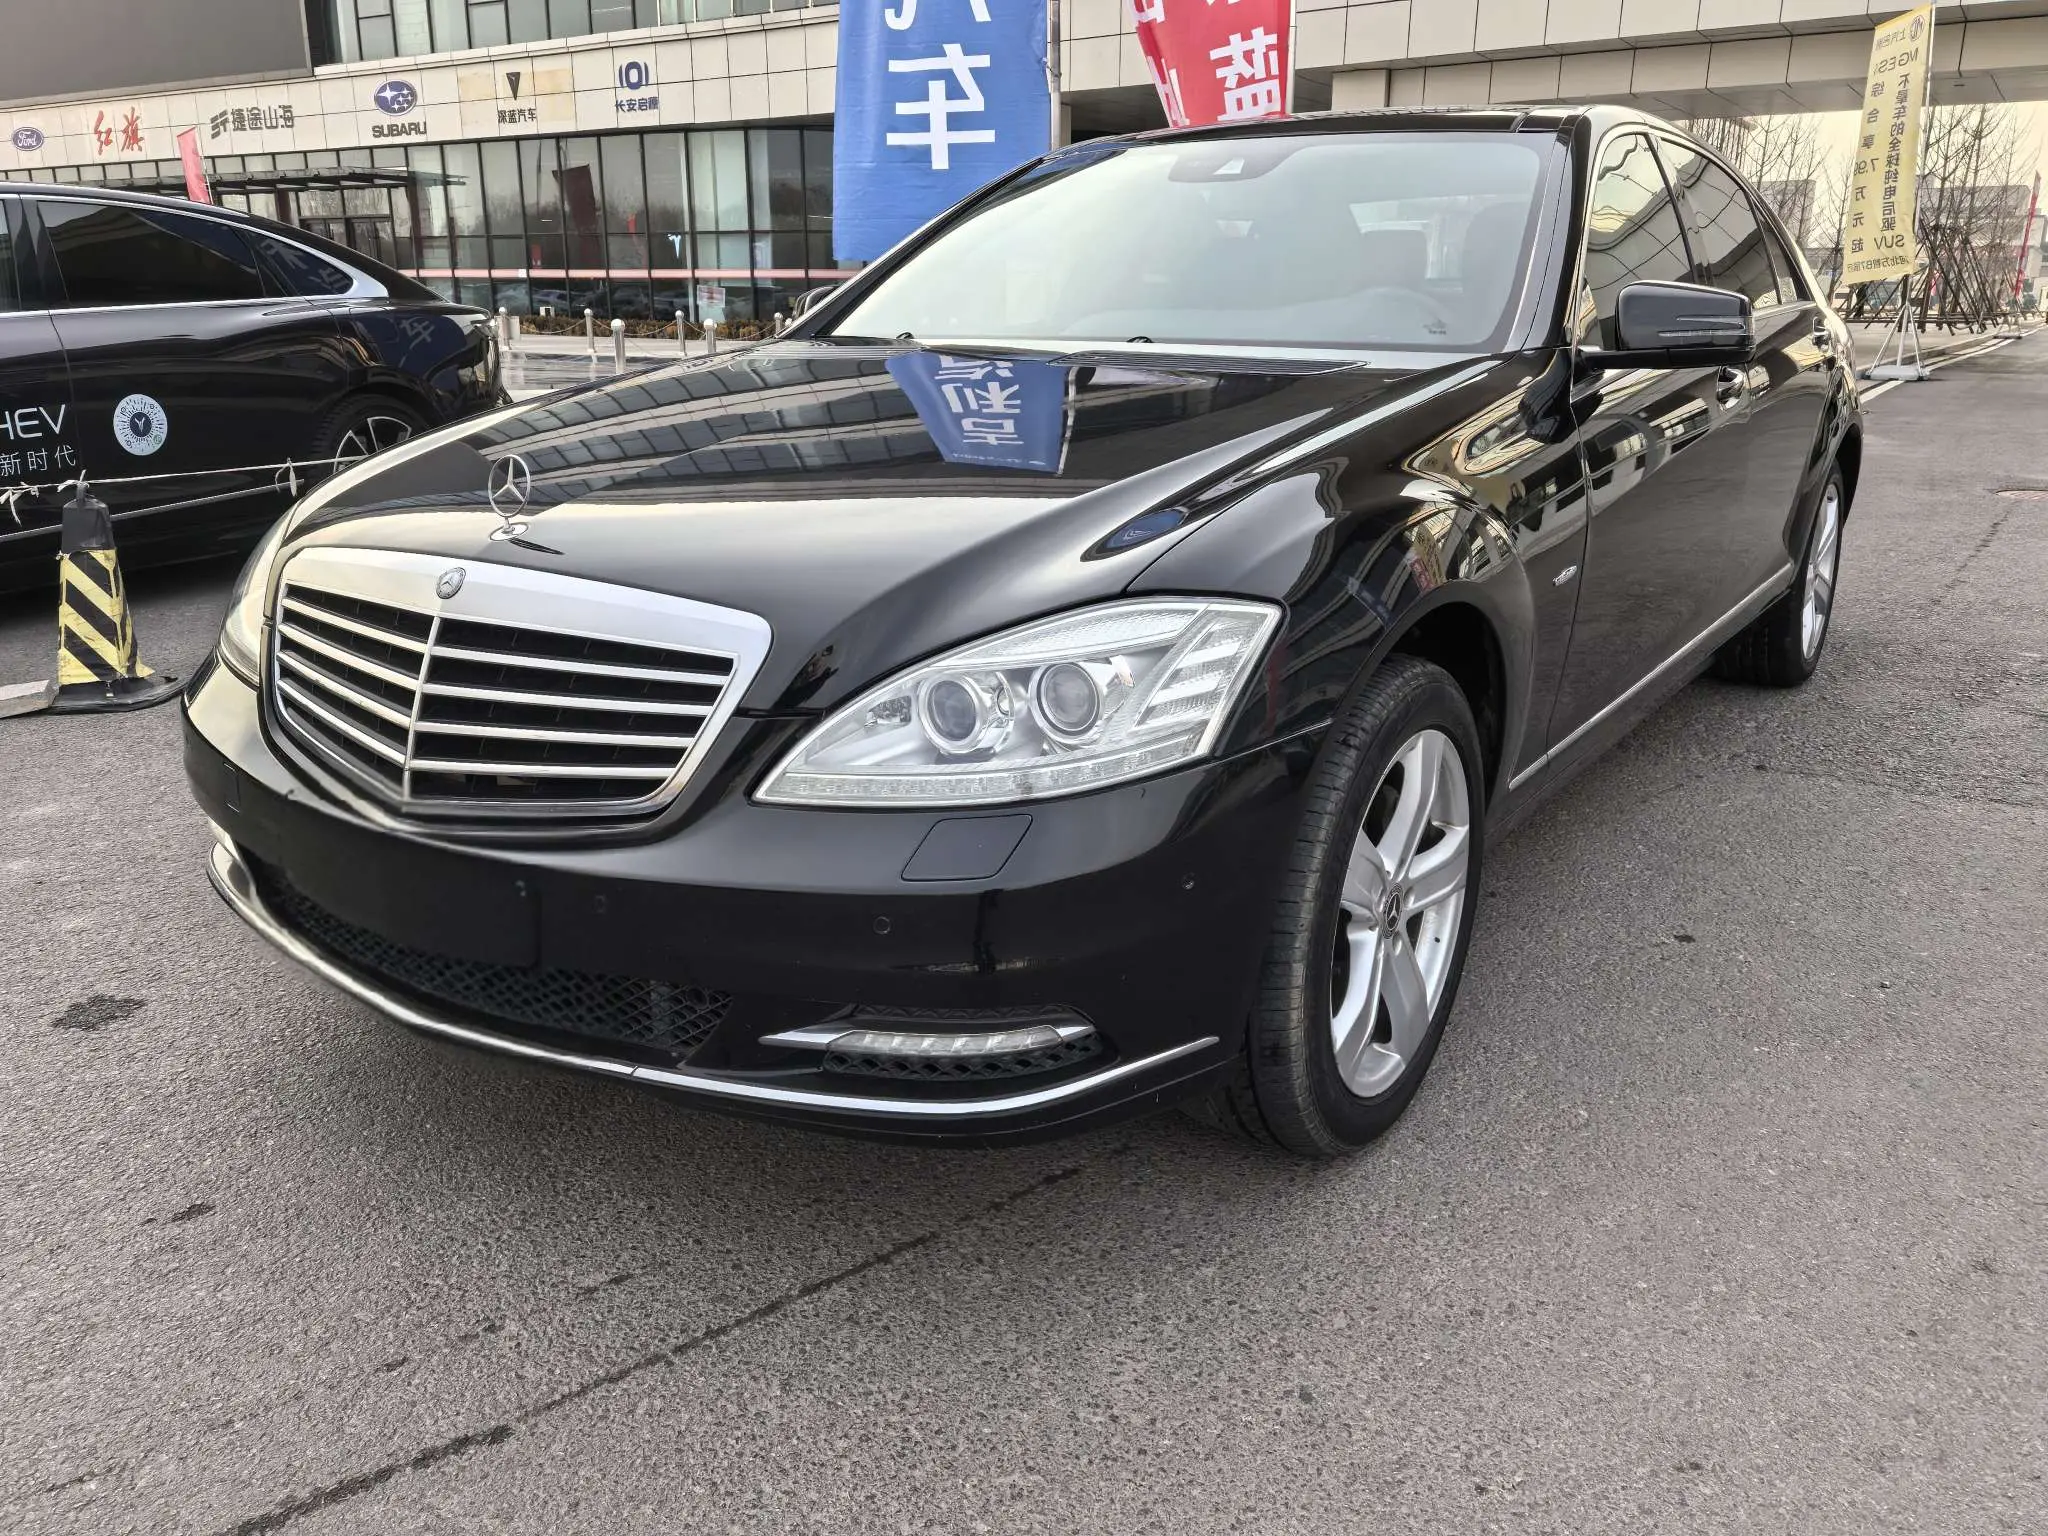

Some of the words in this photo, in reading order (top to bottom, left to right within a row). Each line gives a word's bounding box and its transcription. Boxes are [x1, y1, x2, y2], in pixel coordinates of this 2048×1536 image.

[498, 107, 537, 124] 深蓝汽车
[93, 106, 146, 155] 红旗
[371, 121, 427, 138] SUBARU
[17, 131, 39, 148] Ford
